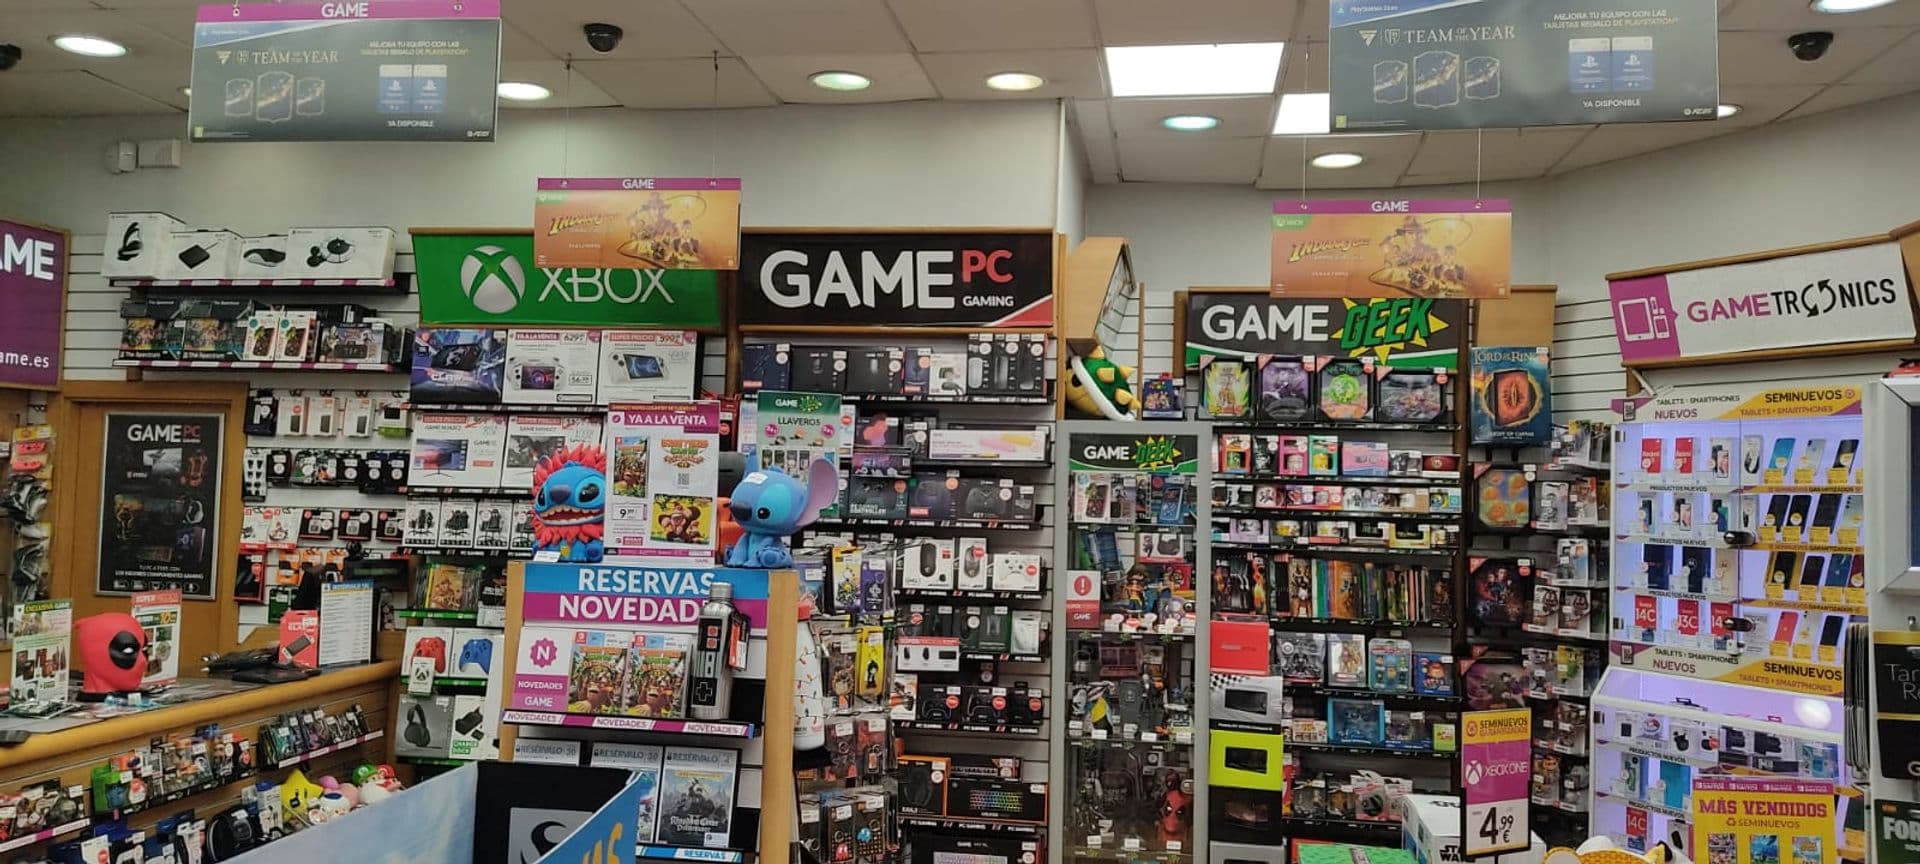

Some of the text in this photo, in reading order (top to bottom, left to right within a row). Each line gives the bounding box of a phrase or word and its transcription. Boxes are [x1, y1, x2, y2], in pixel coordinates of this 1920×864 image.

[321, 3, 368, 17] GAME
[1404, 29, 1453, 44] TEAM
[1470, 25, 1515, 40] YEAR
[252, 50, 338, 65] TEAM YEAR
[1595, 98, 1641, 107] DISPONIBLE
[622, 179, 655, 189] GAME
[1371, 201, 1409, 212] GAME
[0, 234, 55, 281] ME
[538, 268, 675, 304] XBOX
[760, 250, 1015, 310] GAME PC
[963, 296, 1015, 309] GAMING
[1201, 298, 1431, 349] GAME GEEK
[1512, 352, 1538, 363] RIN
[1657, 395, 1740, 406] TABLETS SMARTPHONES
[1764, 390, 1842, 403] SEMINUEVOS
[775, 400, 797, 408] GAME
[628, 414, 707, 425] YA A LA VENTA
[1655, 408, 1698, 420] NUEVOS
[778, 417, 821, 426] LLAVEROS
[127, 424, 201, 443] GAME PC
[1084, 446, 1130, 461] GAME
[619, 508, 627, 518] 9
[579, 568, 715, 595] RESERVAS
[560, 595, 708, 623] NOVEDAD
[1635, 607, 1657, 623] 14C
[1711, 614, 1723, 628] 14
[537, 647, 550, 660] N
[1654, 648, 1739, 664] TABLETS SMARTPHONES
[1653, 659, 1696, 674] NUEVOS
[1764, 662, 1842, 682] SEMINUEVOS
[518, 681, 563, 690] NOVEDADES
[524, 696, 553, 708] GAME
[507, 713, 557, 723] NOVEDADES
[597, 718, 648, 728] NOVEDADES
[1480, 717, 1528, 729] SEMINUEVOS
[687, 724, 739, 734] NOVEDADES
[1484, 761, 1528, 777] XBOX ONE
[1700, 796, 1827, 818] MÁS VENDIDOS
[1479, 806, 1514, 845] 4 99
[1626, 814, 1647, 830] 14C
[1738, 818, 1800, 830] SEMINUEVOS
[1502, 829, 1511, 843] €
[684, 850, 726, 860] RESERVAS
